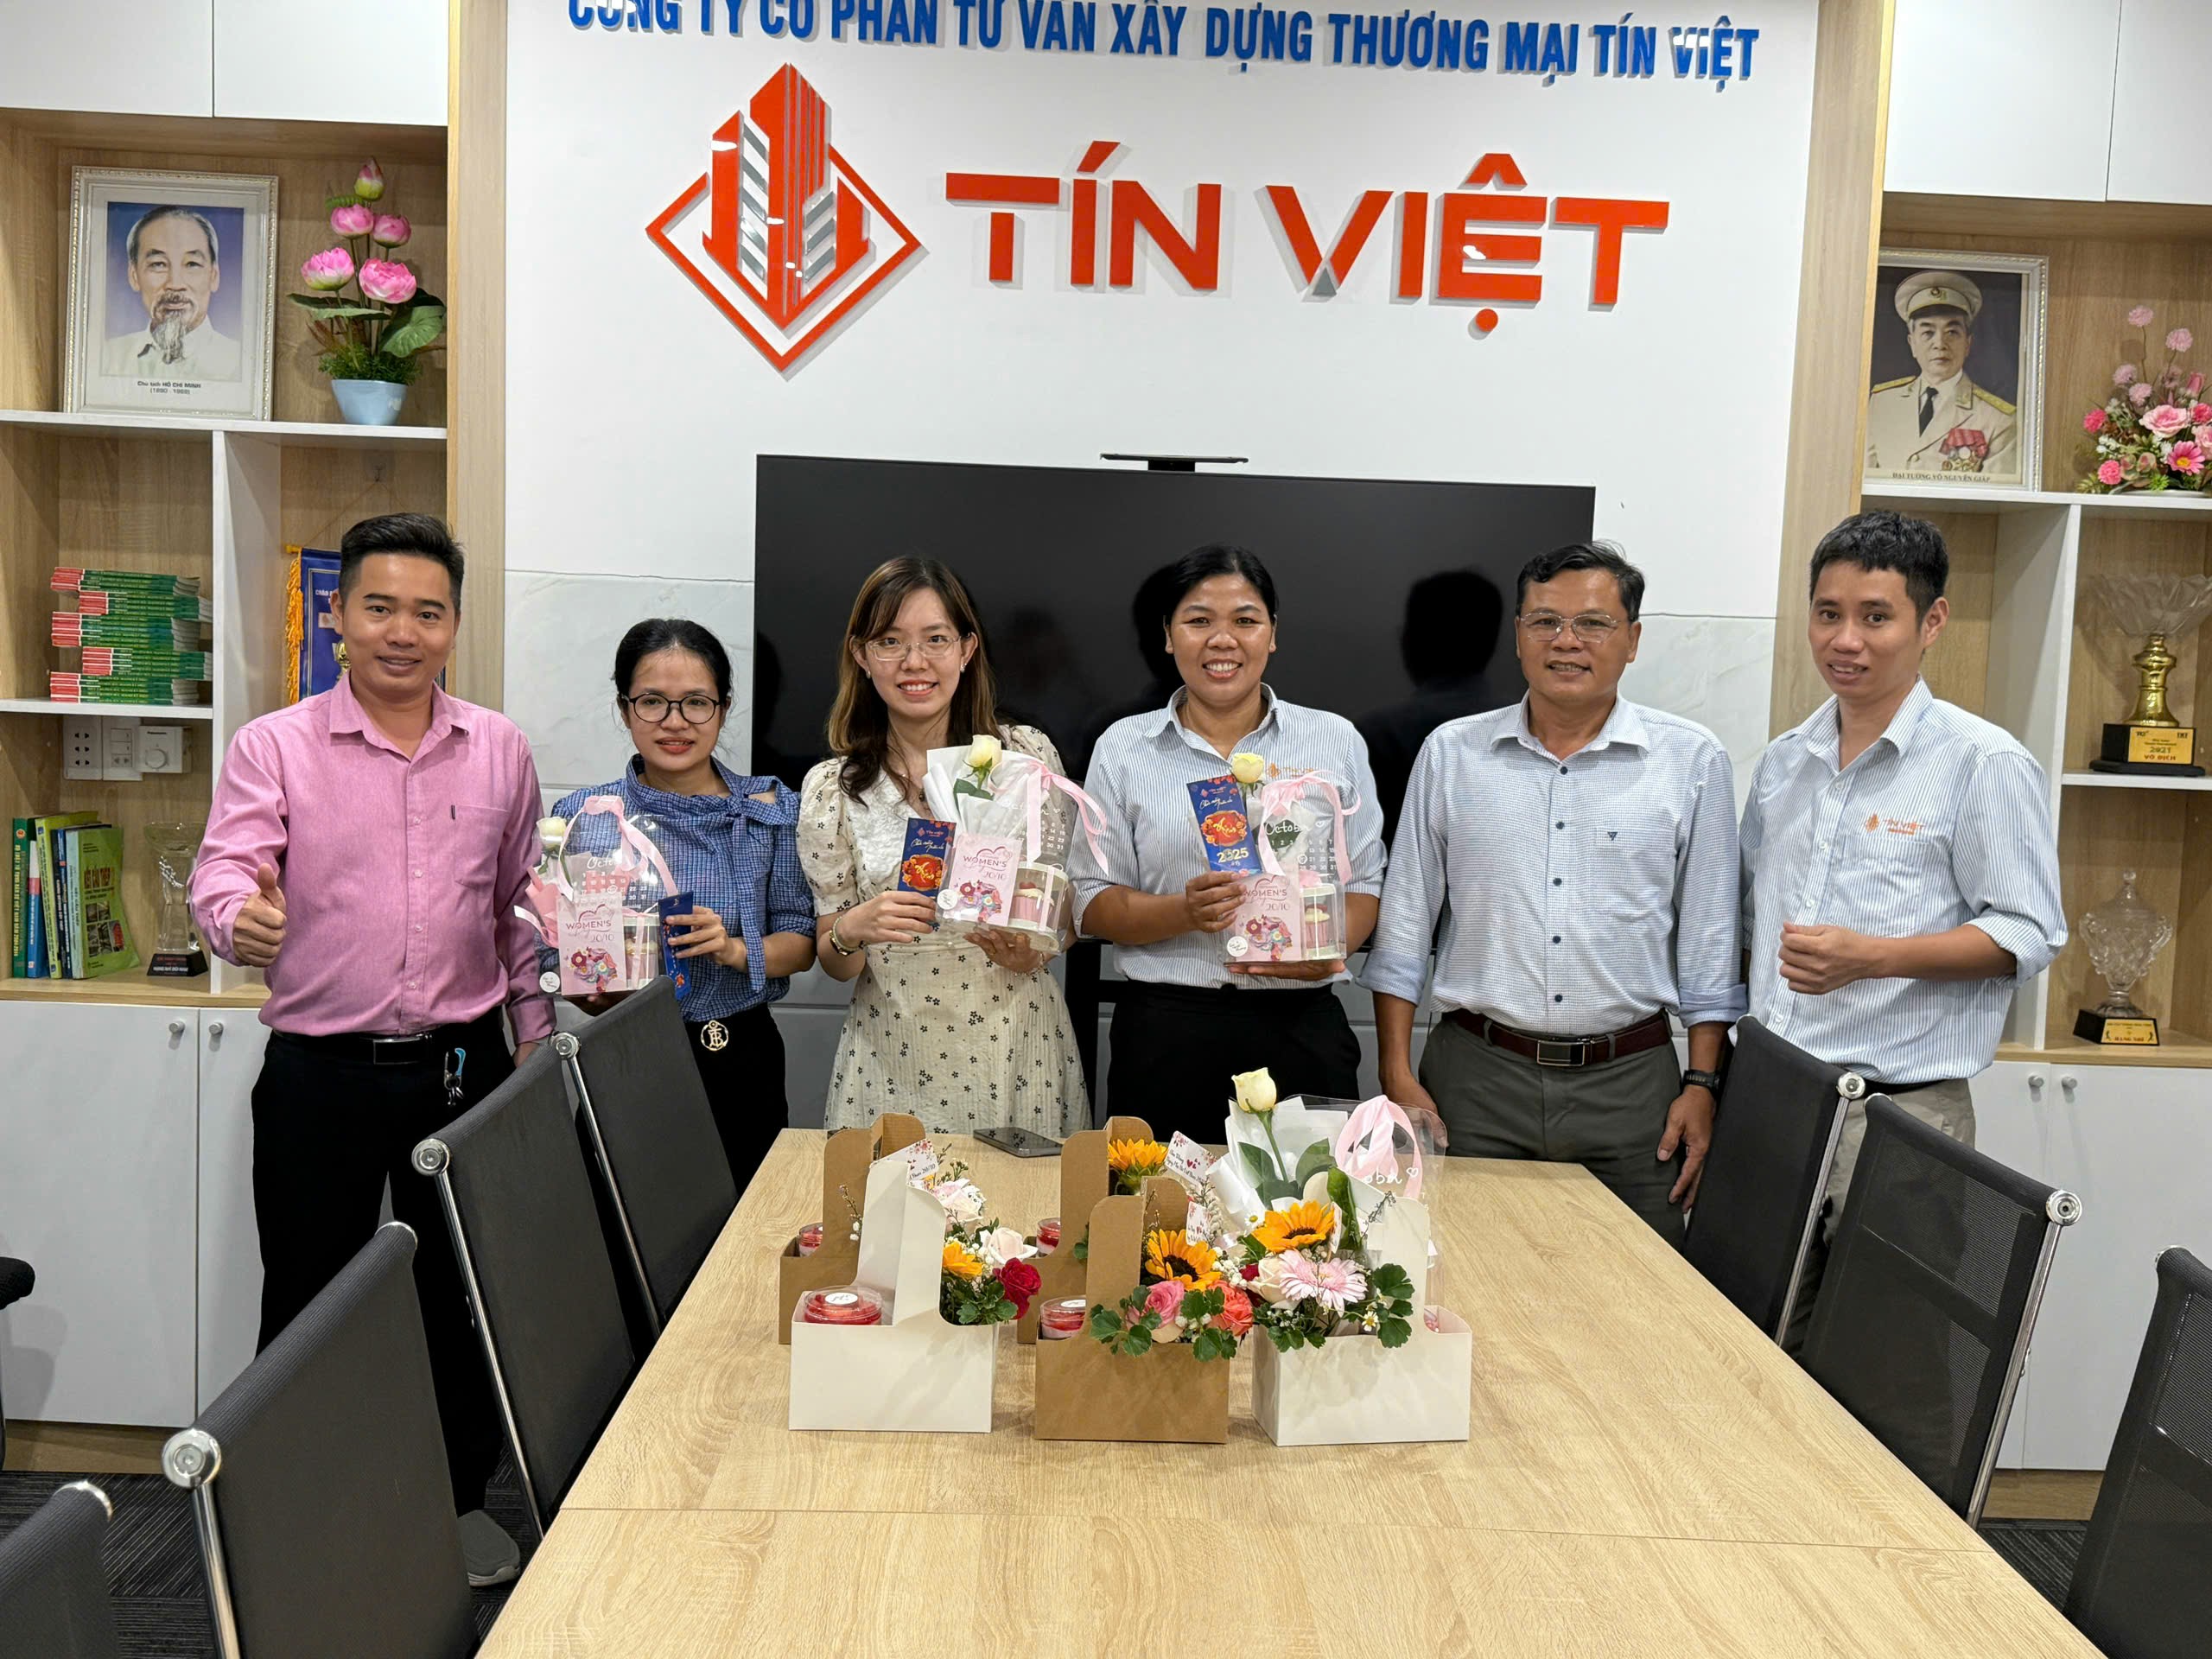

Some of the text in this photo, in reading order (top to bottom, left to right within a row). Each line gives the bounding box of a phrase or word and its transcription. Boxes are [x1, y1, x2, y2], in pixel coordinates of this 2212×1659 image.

[1205, 3, 1313, 73] DỰNG
[1328, 10, 1489, 70] THƯƠNG
[1504, 22, 1580, 84] MẠI
[1594, 12, 1656, 76] TÍN
[1672, 15, 1760, 92] VIỆT
[946, 141, 1669, 334] TÍN VIỆT
[963, 855, 1007, 868] WOMEN'S
[1217, 847, 1249, 863] 2025
[566, 920, 612, 930] WOMEN'S
